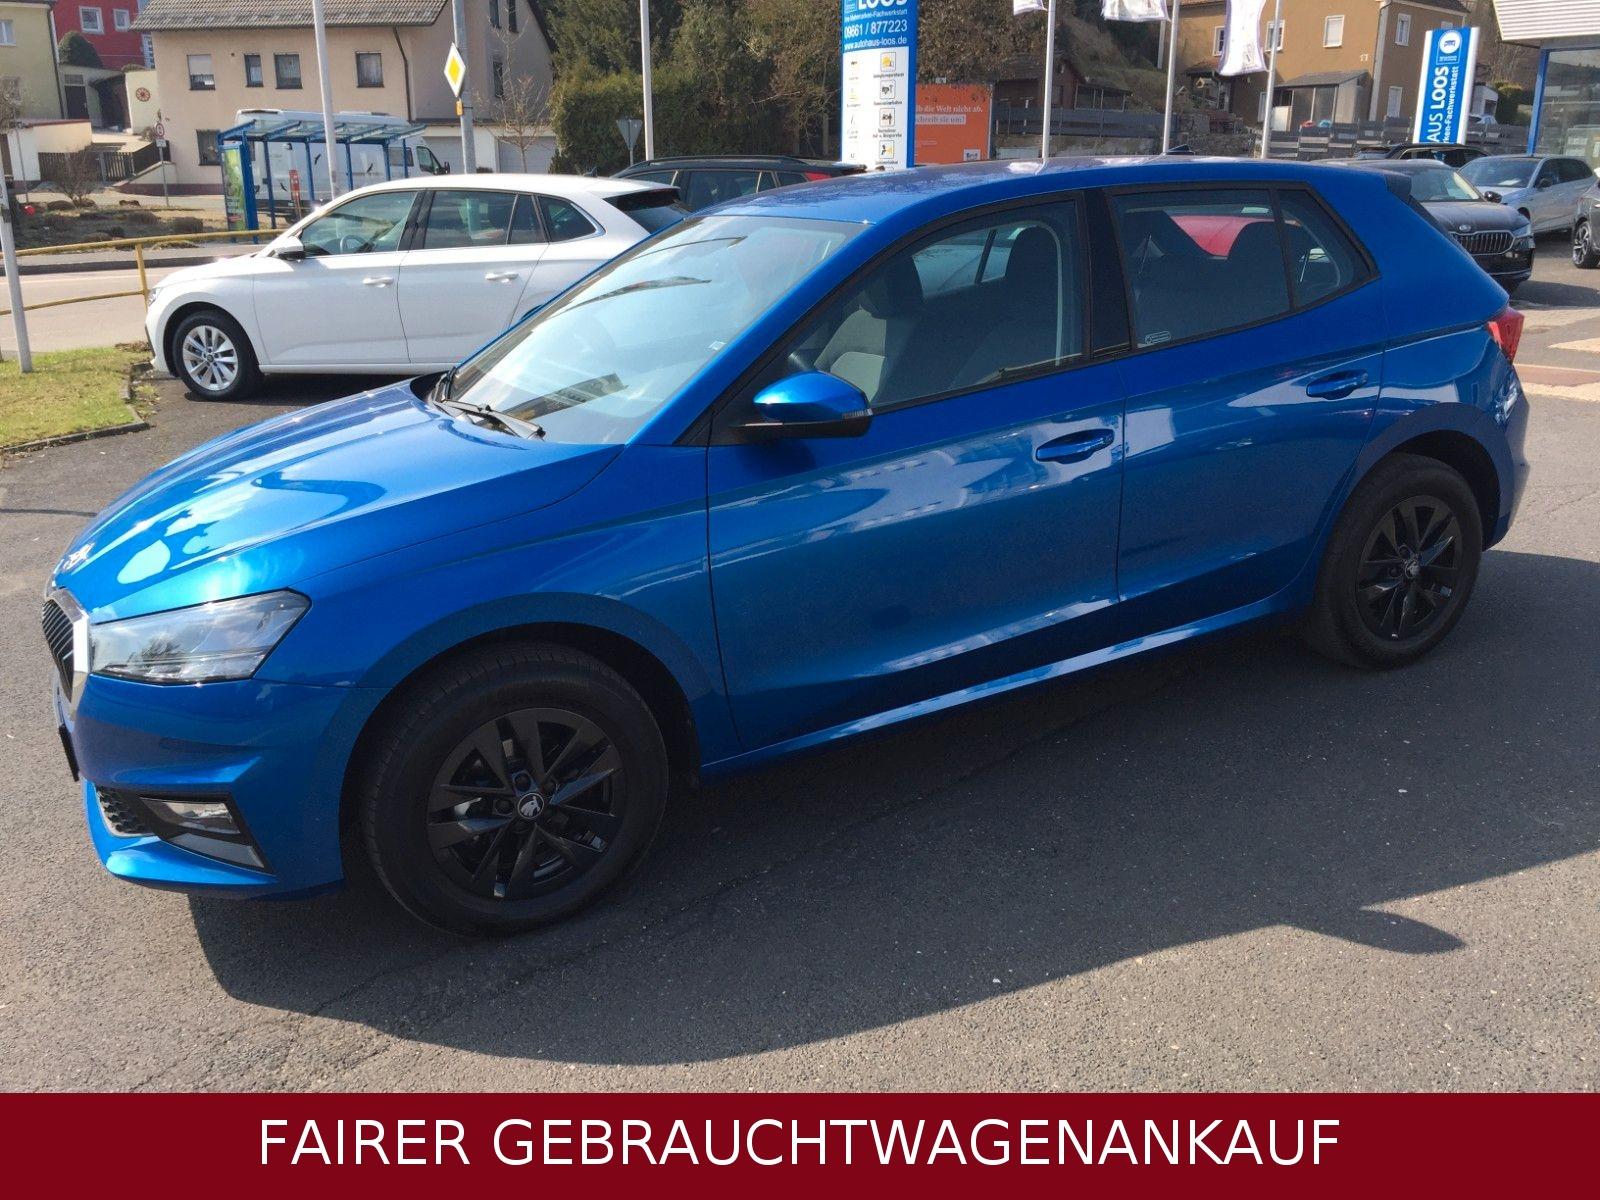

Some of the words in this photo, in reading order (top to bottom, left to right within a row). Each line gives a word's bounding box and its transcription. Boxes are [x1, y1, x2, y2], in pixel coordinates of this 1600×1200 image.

[871, 19, 908, 35] 877223
[844, 35, 908, 50] www.autohaus-loos.de
[1430, 66, 1450, 110] LOOS
[953, 104, 971, 113] nicht
[1427, 112, 1444, 144] AUS
